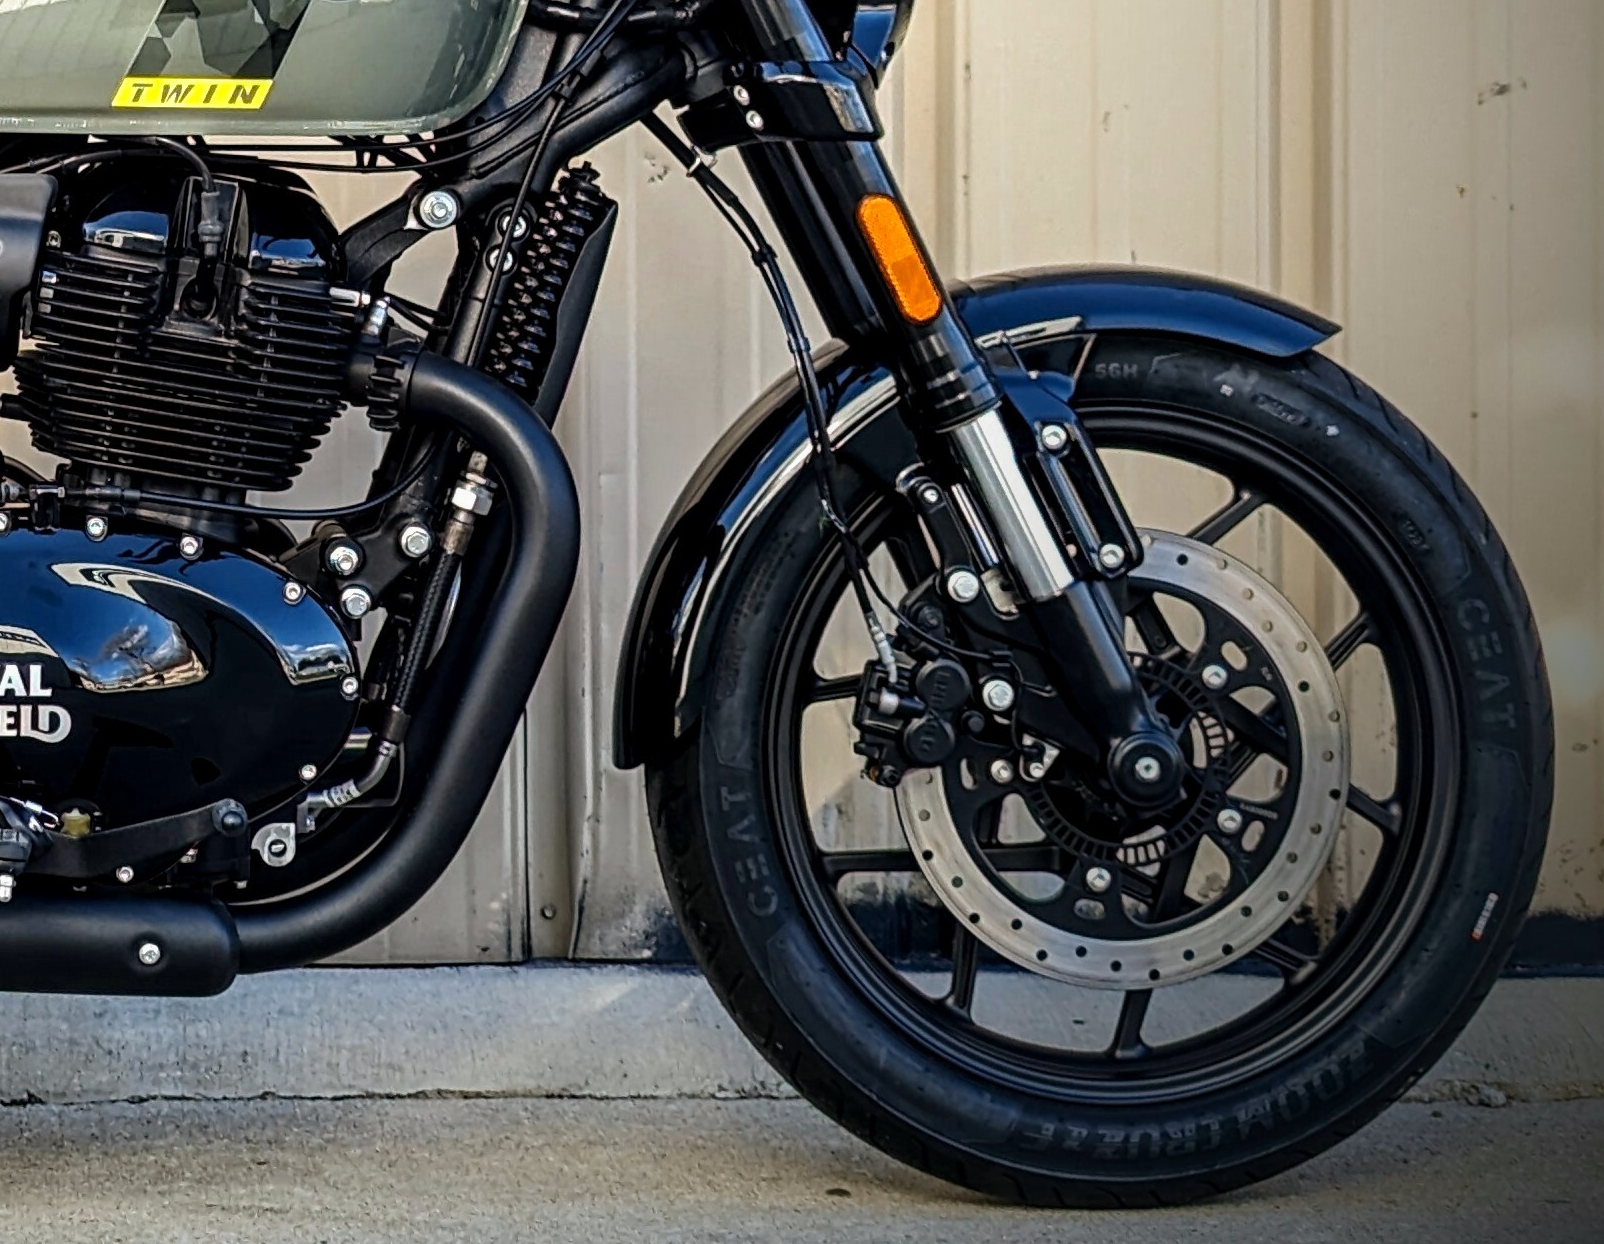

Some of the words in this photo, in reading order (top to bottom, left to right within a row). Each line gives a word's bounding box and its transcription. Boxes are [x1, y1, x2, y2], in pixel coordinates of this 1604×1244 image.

[131, 82, 260, 104] TWIN
[1457, 598, 1517, 730] CEAT
[718, 784, 778, 918] CEAT
